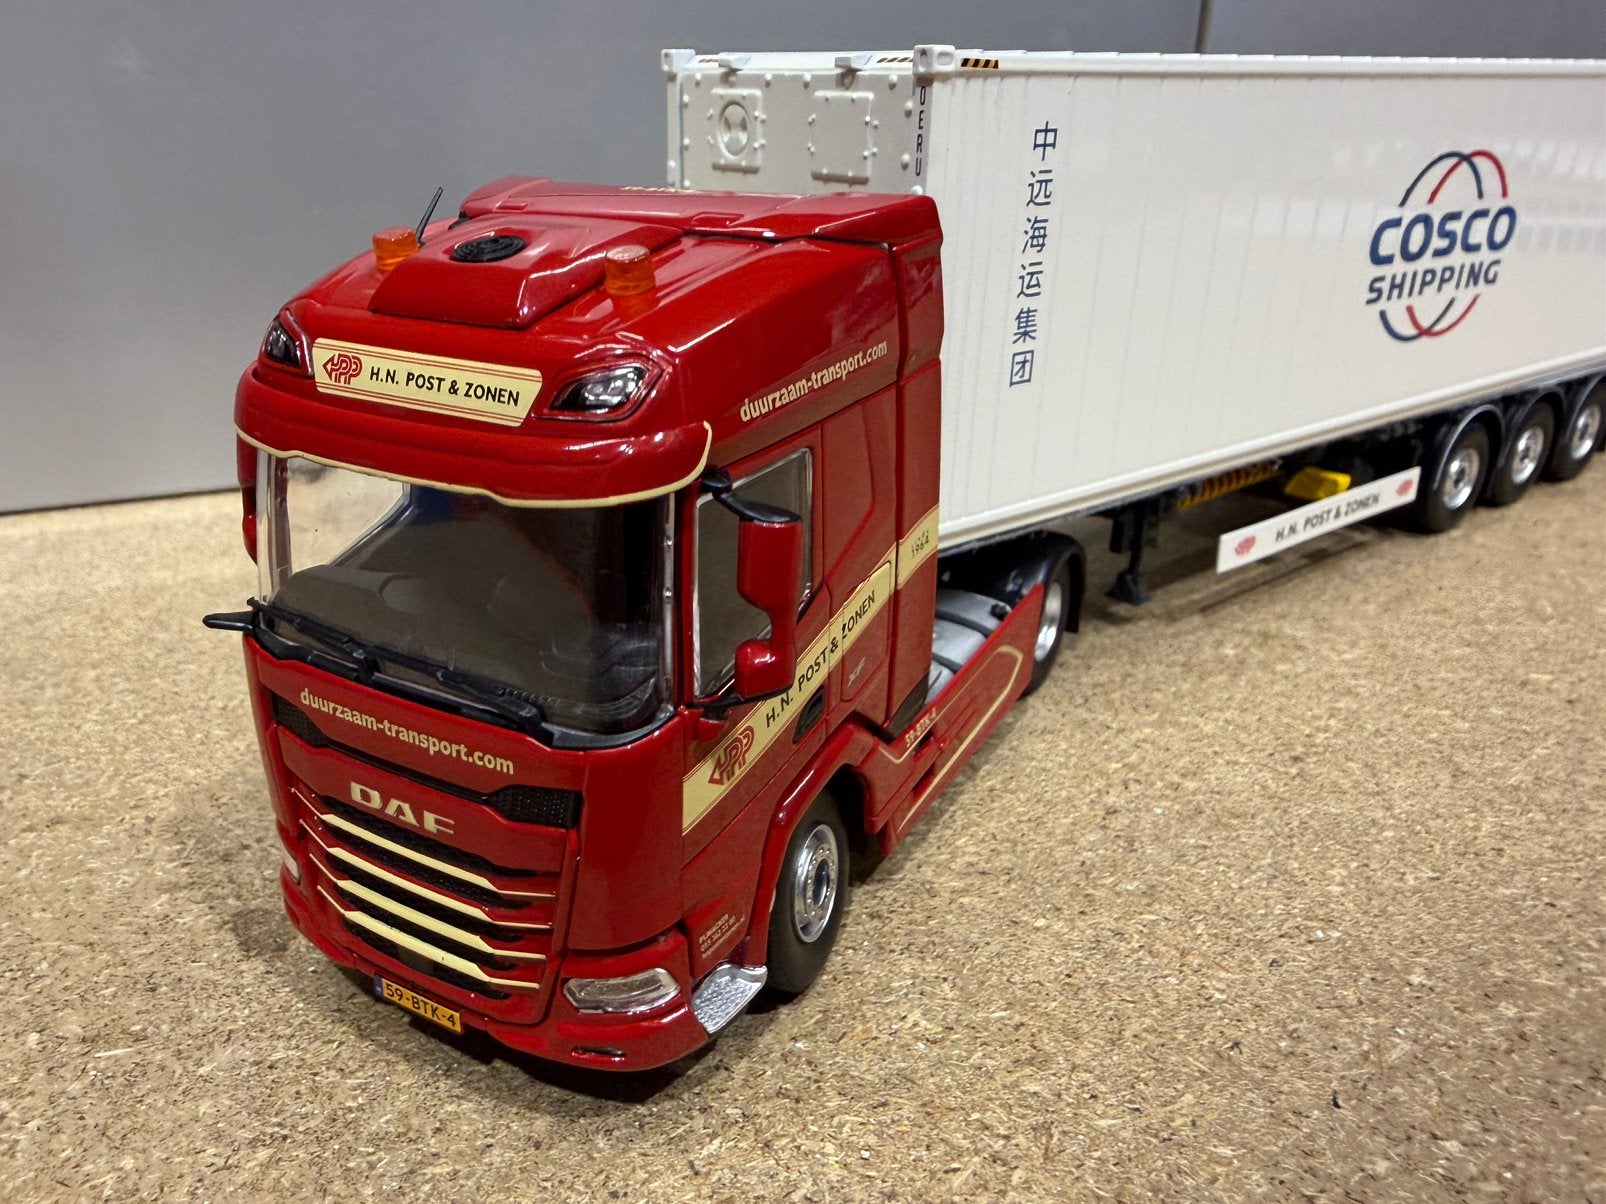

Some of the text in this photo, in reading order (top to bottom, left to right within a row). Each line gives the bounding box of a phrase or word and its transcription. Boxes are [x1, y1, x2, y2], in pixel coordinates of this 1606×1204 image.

[1009, 120, 1058, 388] 中远海运集团
[1369, 205, 1517, 266] COSCO
[1366, 259, 1502, 305] SHIPPING
[369, 366, 520, 407] H.N. POST & ZONEN
[739, 341, 888, 422] duurzaam-transport.com
[1275, 492, 1381, 543] H.N. POST & ZONEN
[765, 589, 876, 729] H.N. POST & ZONEN
[299, 687, 514, 775] duurzaam-transport.com
[350, 780, 455, 835] DAF
[385, 983, 456, 1028] 59-BTK-4
